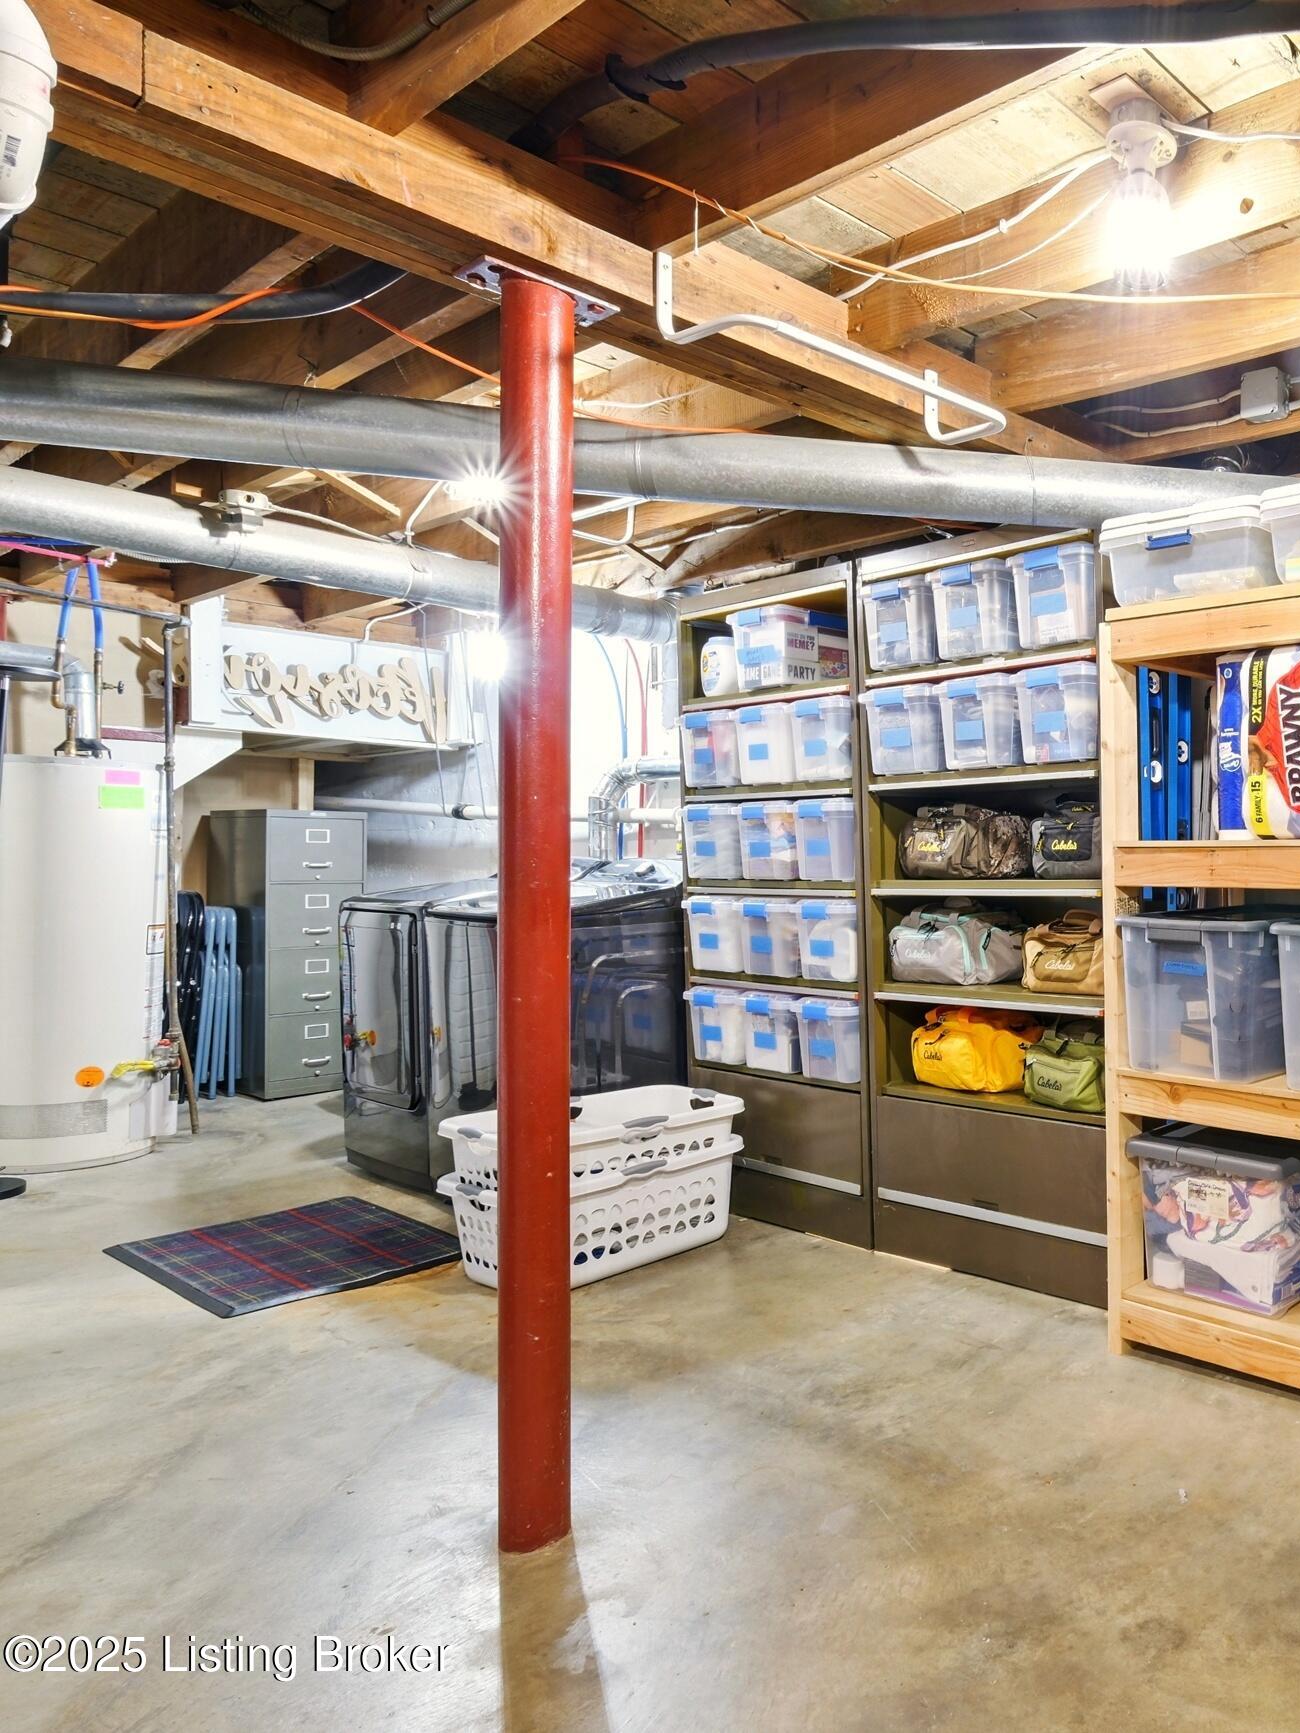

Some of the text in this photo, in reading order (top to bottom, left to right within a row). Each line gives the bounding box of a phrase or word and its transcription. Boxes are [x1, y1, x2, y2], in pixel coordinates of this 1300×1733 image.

[787, 638, 815, 651] MEME?
[788, 664, 816, 681] PARTY
[1252, 705, 1262, 723] 2X
[1251, 781, 1261, 793] 15
[1255, 794, 1263, 816] FAMILY
[923, 1051, 943, 1062] Cabela's
[1036, 1076, 1063, 1092] Cabela's
